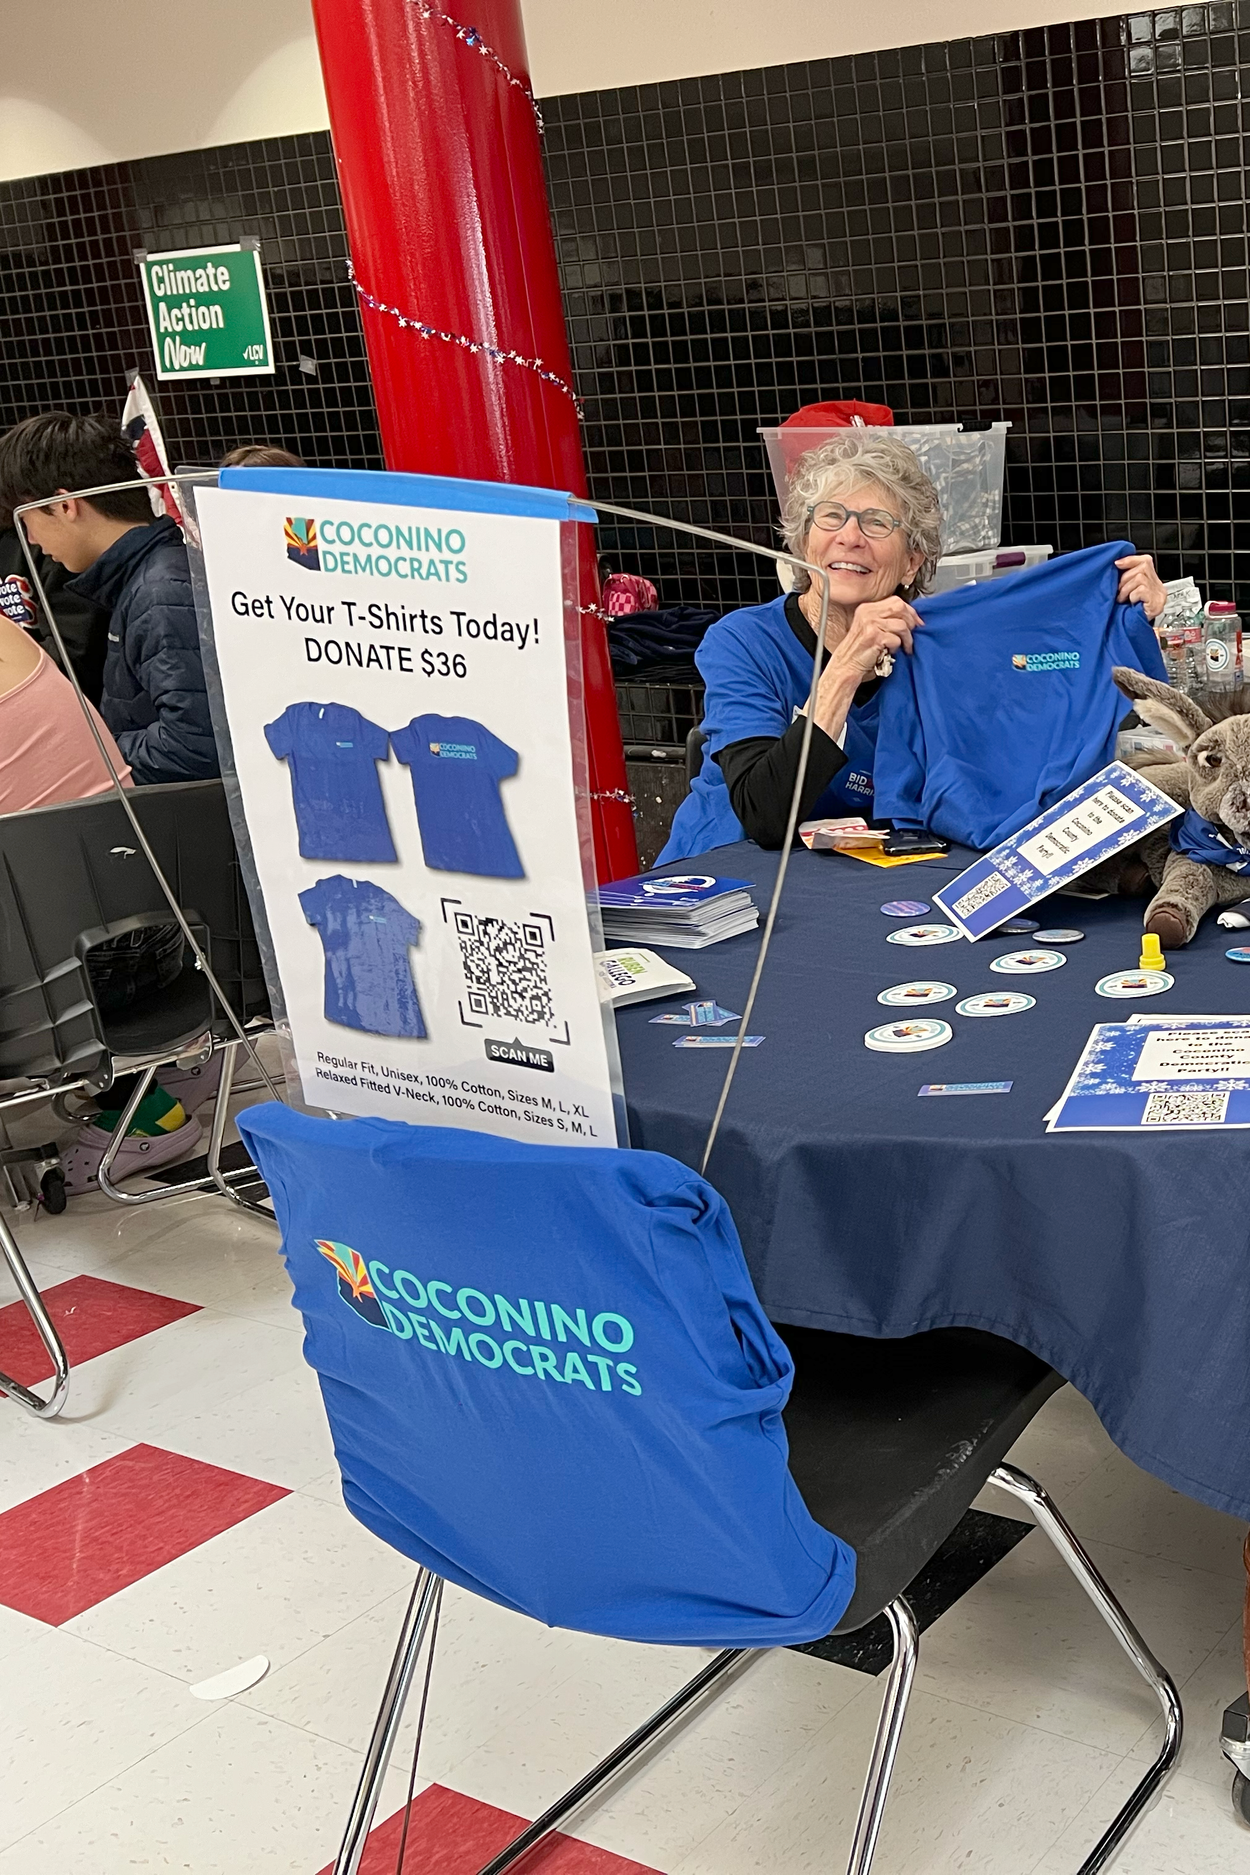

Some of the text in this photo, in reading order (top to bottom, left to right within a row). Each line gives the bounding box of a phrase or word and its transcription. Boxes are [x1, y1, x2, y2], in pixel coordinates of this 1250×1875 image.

[151, 262, 231, 297] Climate
[158, 298, 225, 333] Action
[164, 335, 206, 370] Now
[319, 520, 466, 554] COCONINO
[321, 551, 468, 584] DEMOCRATS
[3, 605, 25, 616] vote
[231, 591, 539, 650] Get Your T-Shirts Today!
[304, 637, 468, 678] DONATE $36
[1026, 651, 1080, 664] COCONINO
[1026, 660, 1080, 672] DEMOCRATS
[845, 781, 875, 797] HARRI
[490, 1045, 549, 1067] SCAN ME
[315, 1067, 598, 1137] Relaxed Fitted V-Neck, 100% Cotton, Sizes S, M, L
[317, 1051, 590, 1118] Regular Fit, Unisex, 100% Cotton, Sizes M, L, XL
[368, 1260, 635, 1354] COCONINO
[386, 1308, 642, 1397] DEMOCRATS
